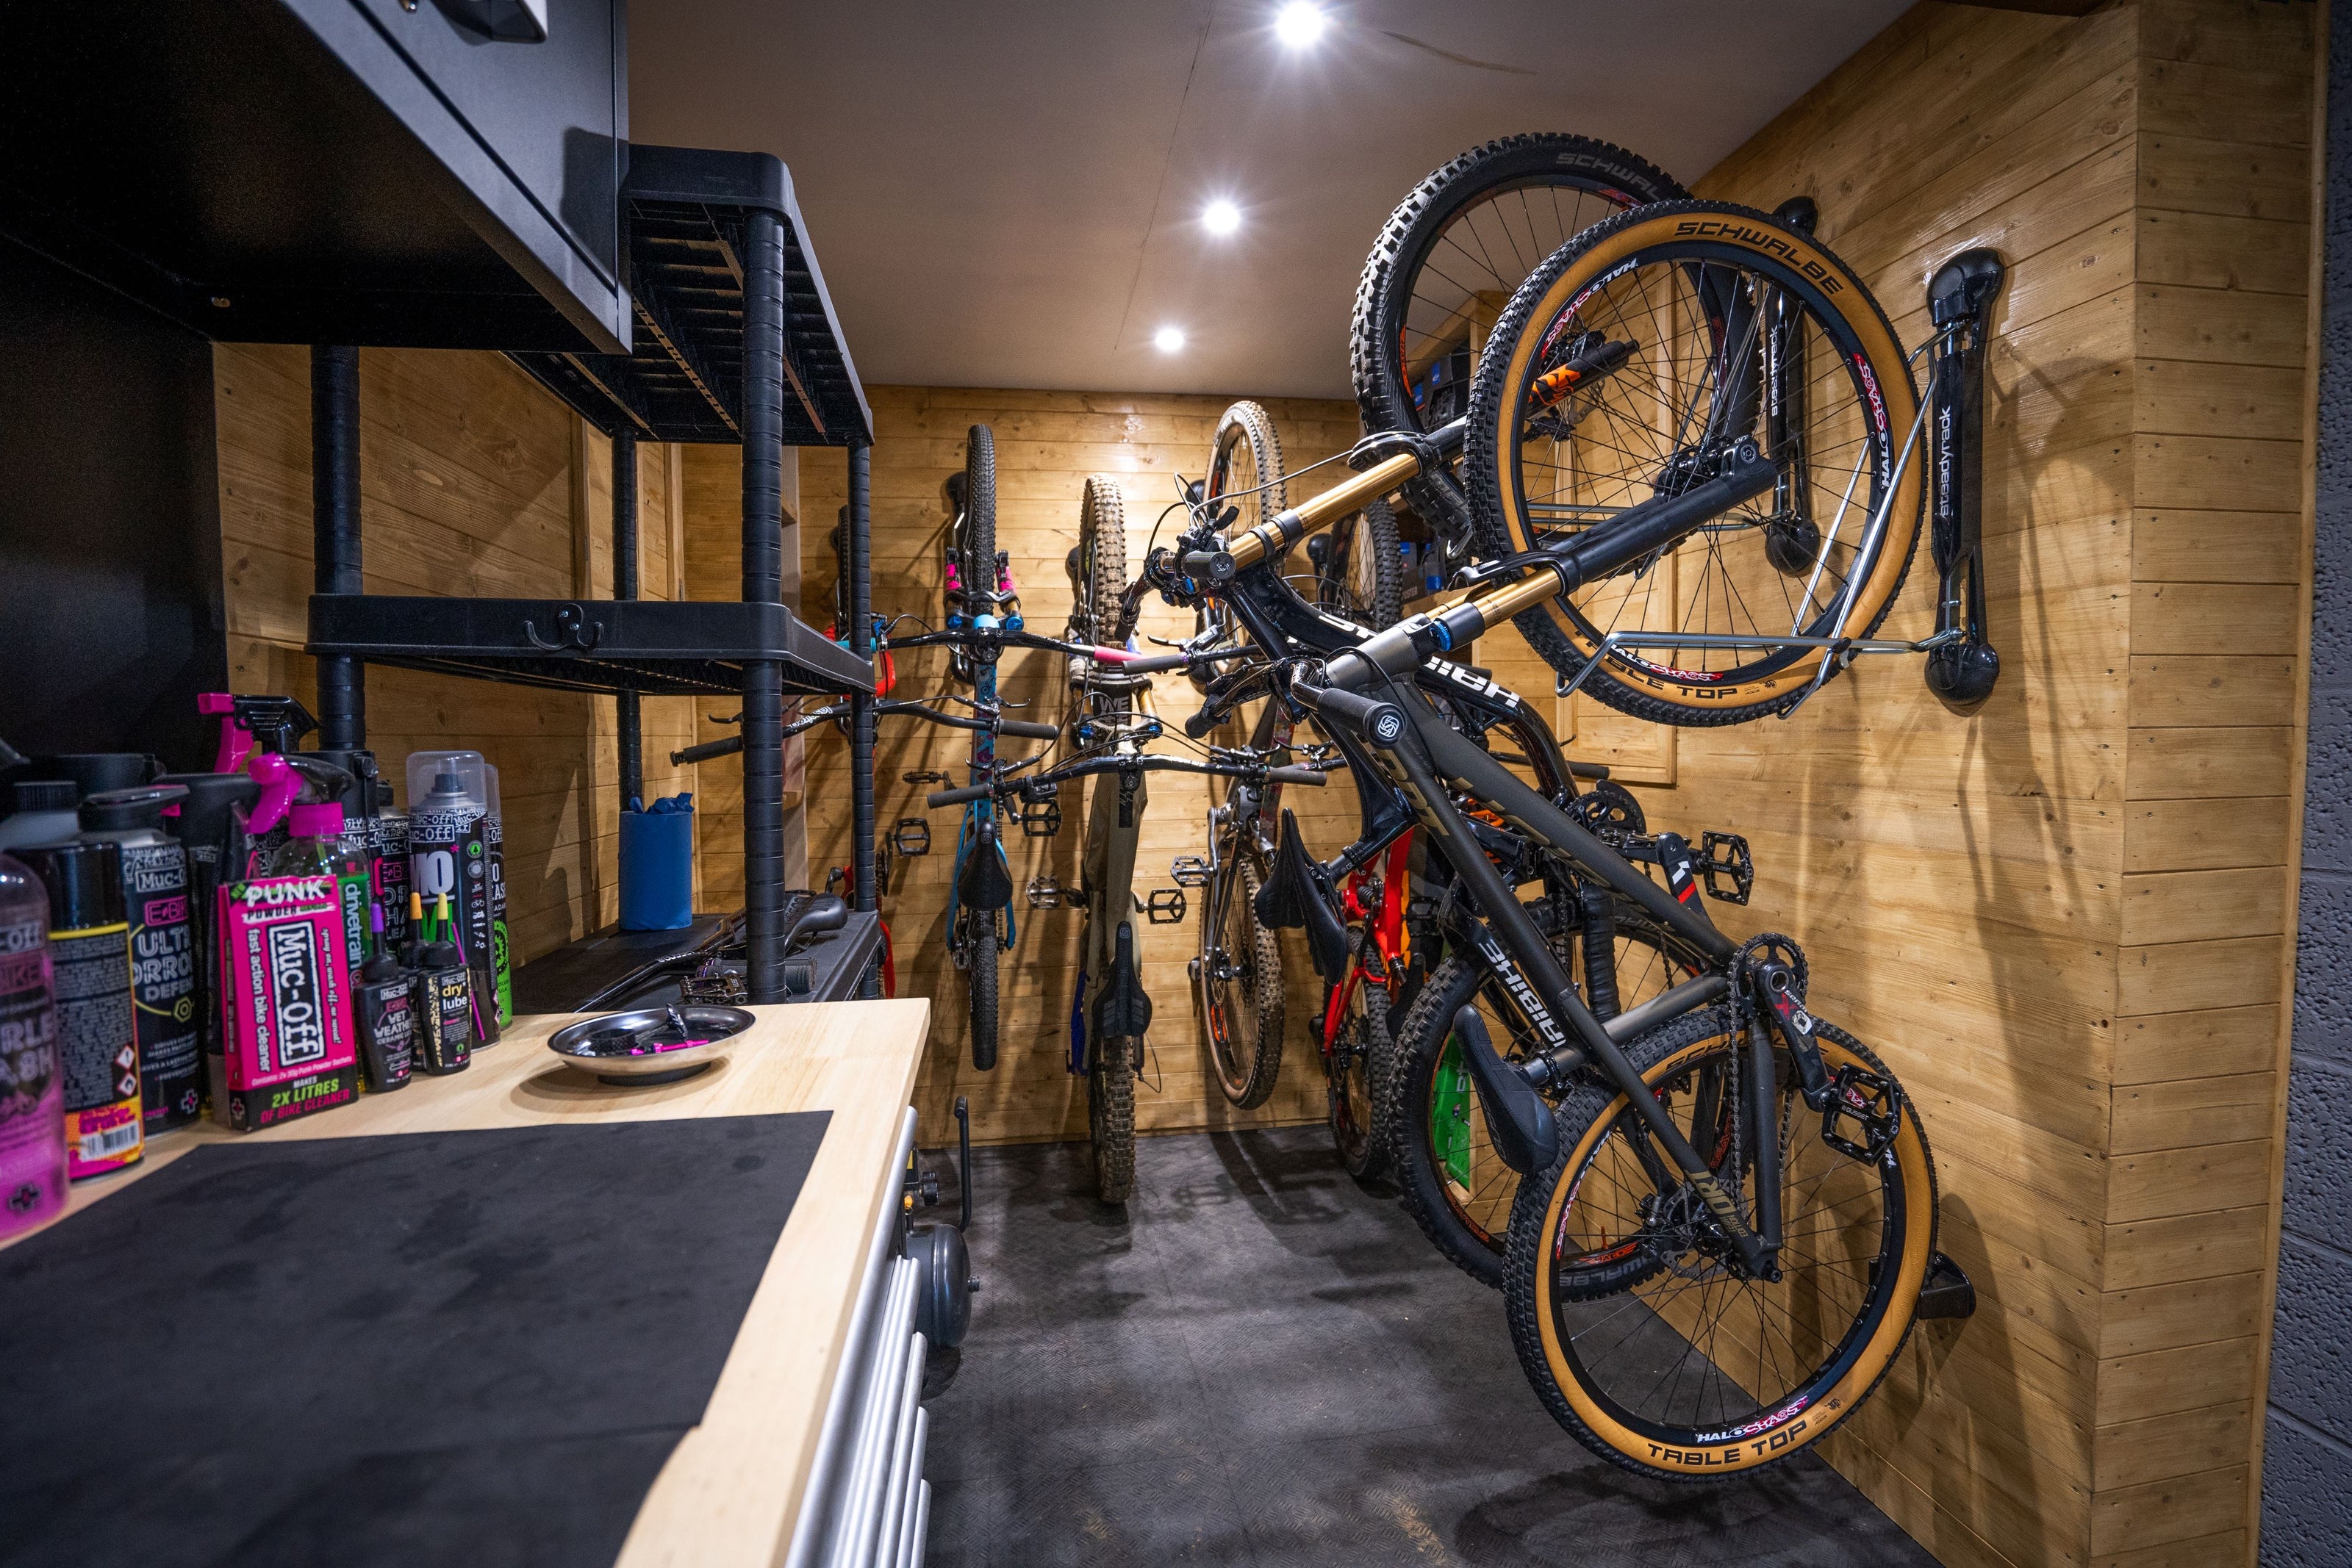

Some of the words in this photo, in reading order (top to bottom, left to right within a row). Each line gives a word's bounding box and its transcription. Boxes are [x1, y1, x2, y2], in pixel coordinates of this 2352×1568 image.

[1556, 152, 1662, 202] SCHWAL
[1675, 222, 1844, 294] SCHWALBE
[1770, 325, 1779, 417] steadyrack
[1879, 429, 1891, 488] HALO
[1939, 406, 1954, 519] steadyrack
[1677, 686, 1738, 699] TOP
[245, 879, 326, 908] PUNK
[247, 905, 298, 920] POWDER
[345, 882, 362, 970] drivetrain
[248, 928, 262, 954] fast
[251, 955, 265, 995] action
[276, 929, 319, 1057] Muc-Off
[442, 996, 468, 1010] lube
[254, 996, 270, 1024] bike
[331, 1006, 337, 1017] no
[387, 1010, 406, 1024] WET
[257, 1025, 271, 1072] cleaner
[271, 1090, 291, 1109] 2X
[294, 1078, 340, 1104] LITRES
[293, 1075, 318, 1088] MAKES
[260, 1110, 275, 1124] OF
[277, 1101, 303, 1119] BIKE
[304, 1088, 351, 1112] CLEANER
[1846, 1107, 1870, 1121] GUSSET
[1727, 1215, 1749, 1237] EDITION
[1559, 1259, 1642, 1286] WALBE
[1648, 1442, 1741, 1466] TABLE
[1751, 1420, 1807, 1456] TOP
[1697, 1428, 1746, 1443] HALO
